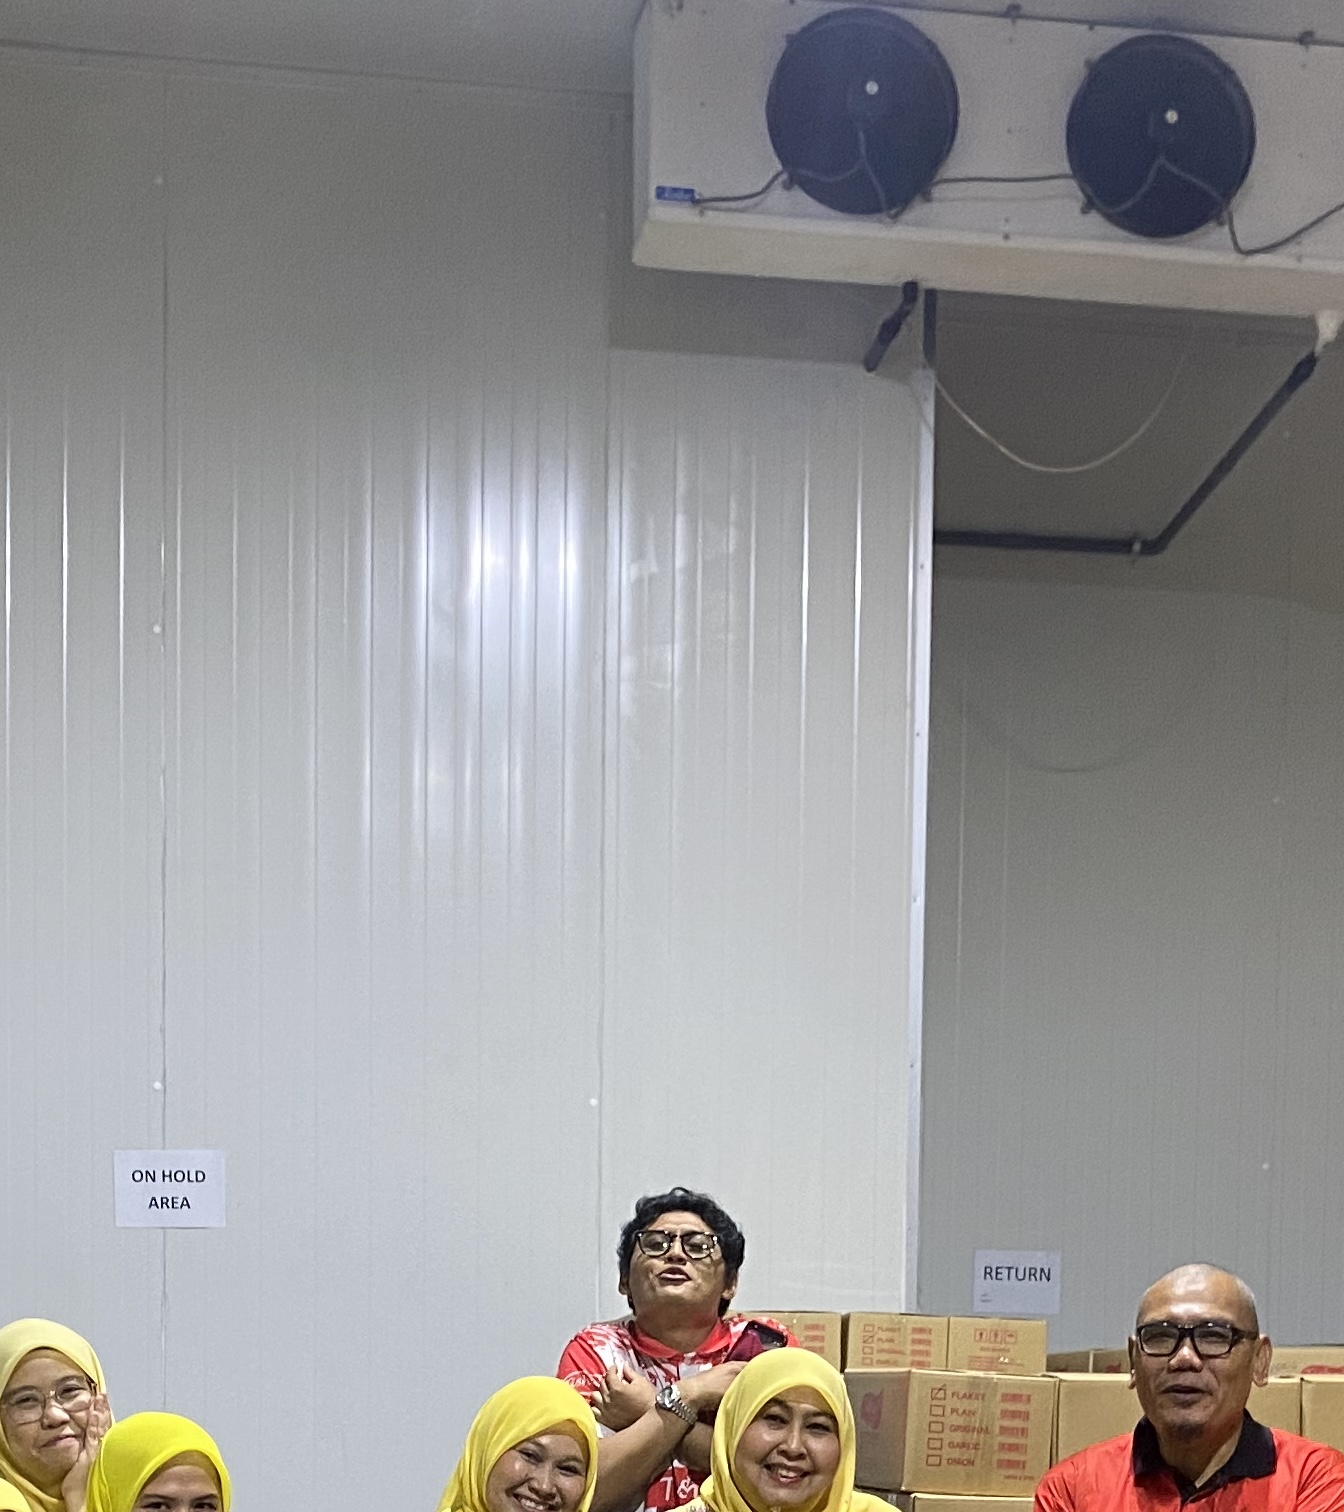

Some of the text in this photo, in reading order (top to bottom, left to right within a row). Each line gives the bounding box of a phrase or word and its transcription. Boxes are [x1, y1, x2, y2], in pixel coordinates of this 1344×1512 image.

[131, 1169, 207, 1184] ON HOLD
[148, 1195, 192, 1211] AREA
[983, 1265, 1052, 1283] RETURN
